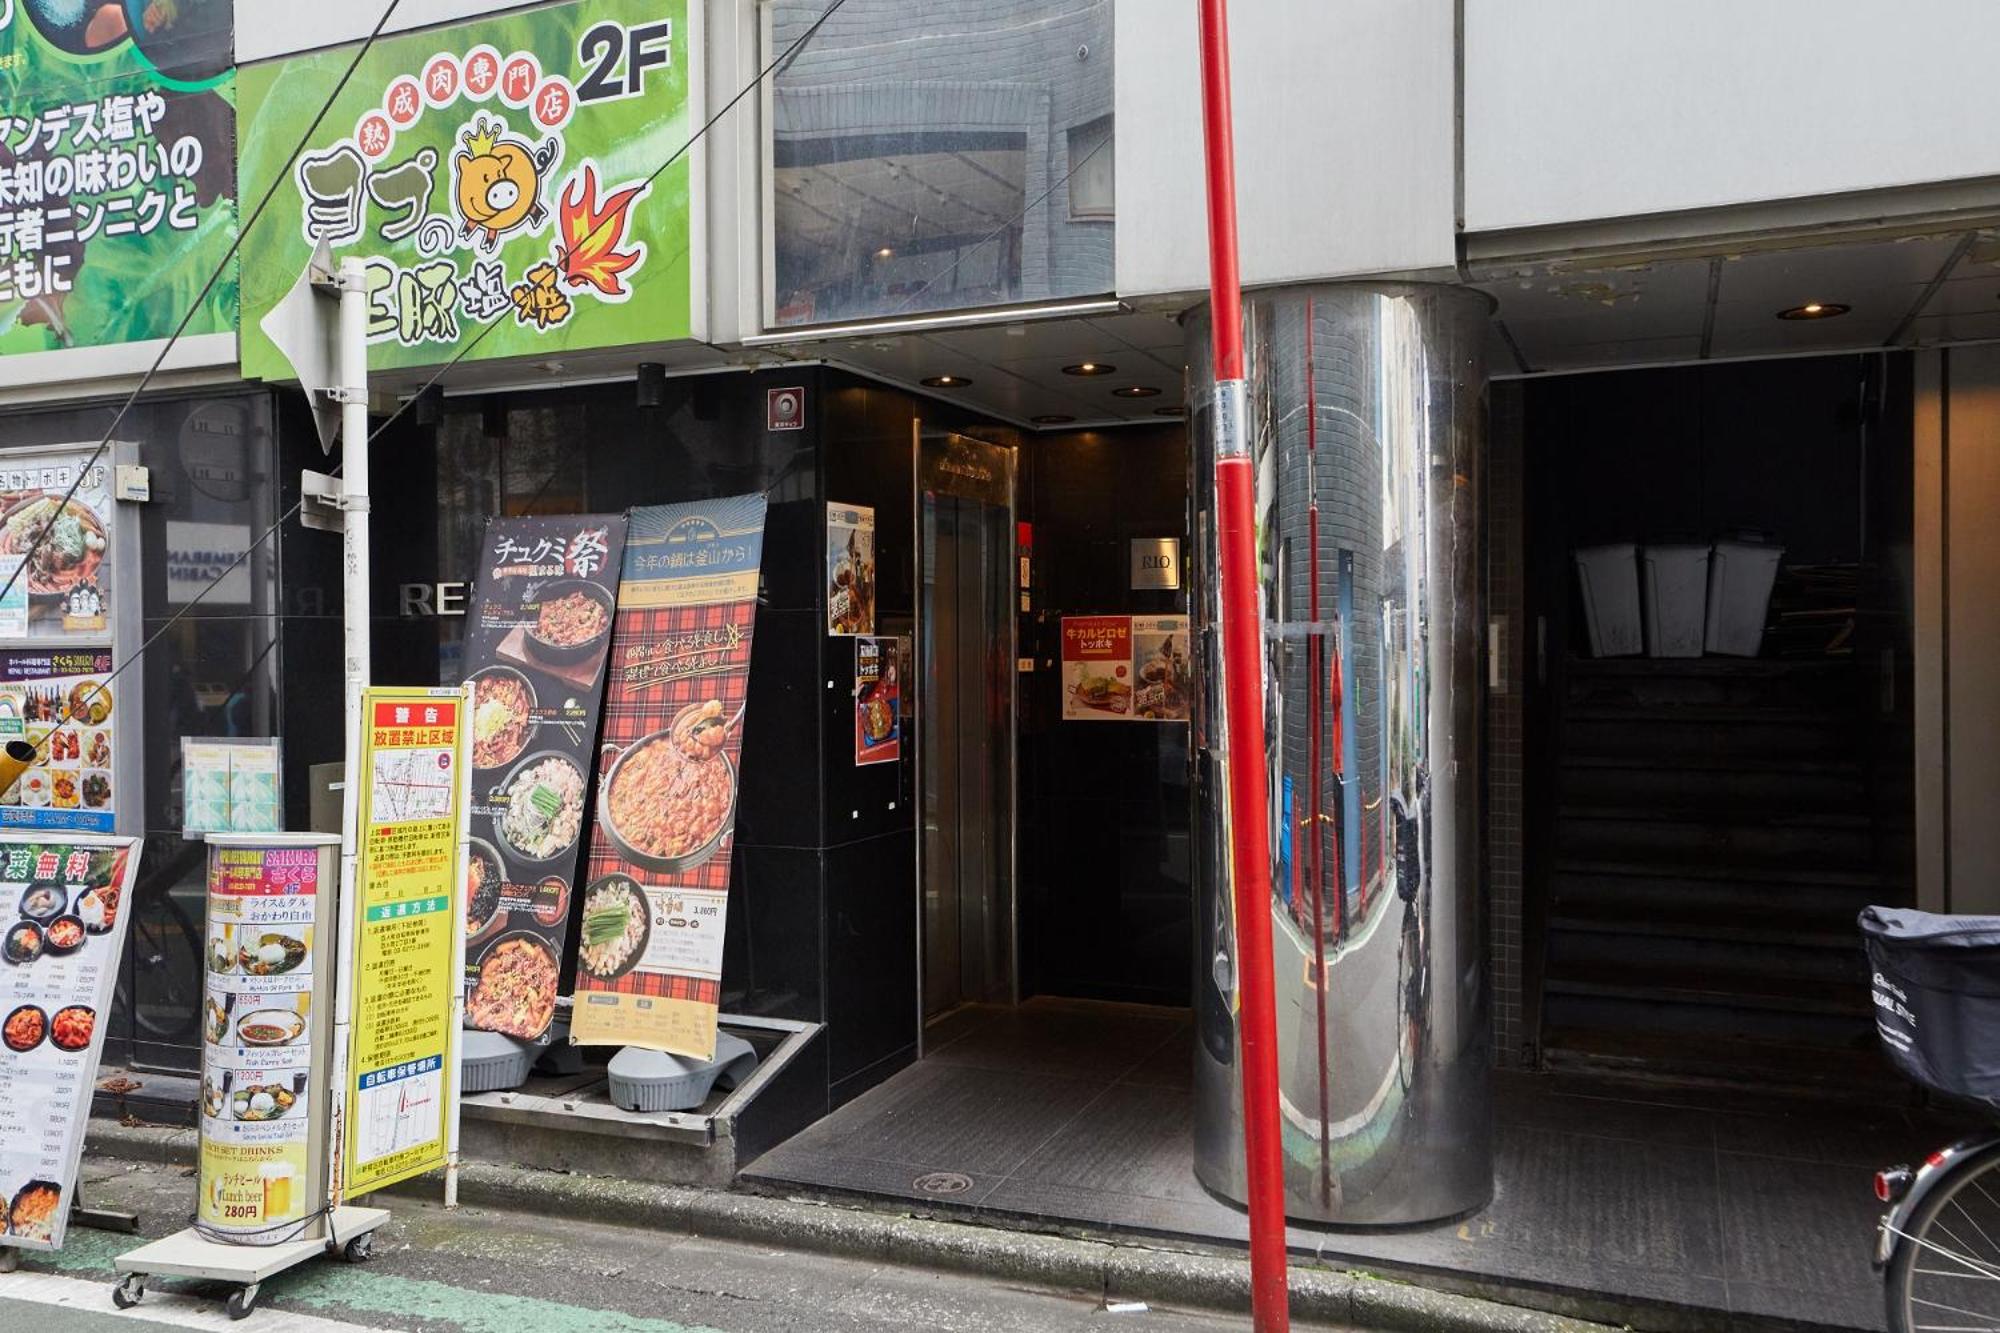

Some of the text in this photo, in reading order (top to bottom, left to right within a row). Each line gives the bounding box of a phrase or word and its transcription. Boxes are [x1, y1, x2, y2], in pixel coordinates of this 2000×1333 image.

[576, 24, 669, 102] 2F
[494, 528, 608, 579] チュグミ祭
[1142, 555, 1170, 569] RIO
[400, 582, 475, 616] RE
[1066, 626, 1128, 640] 牛カルビロゼ
[1080, 639, 1113, 650] トッポキ
[53, 654, 72, 667] さくら
[374, 729, 454, 746] 放置禁止区域
[266, 849, 317, 866] SAKURA
[271, 865, 316, 883] さくら
[249, 911, 312, 921] おかわり自由
[365, 1057, 437, 1087] 自転車保管場所
[240, 1145, 284, 1155] DRINKS
[244, 1189, 263, 1202] beer
[224, 1205, 257, 1218] 280円
